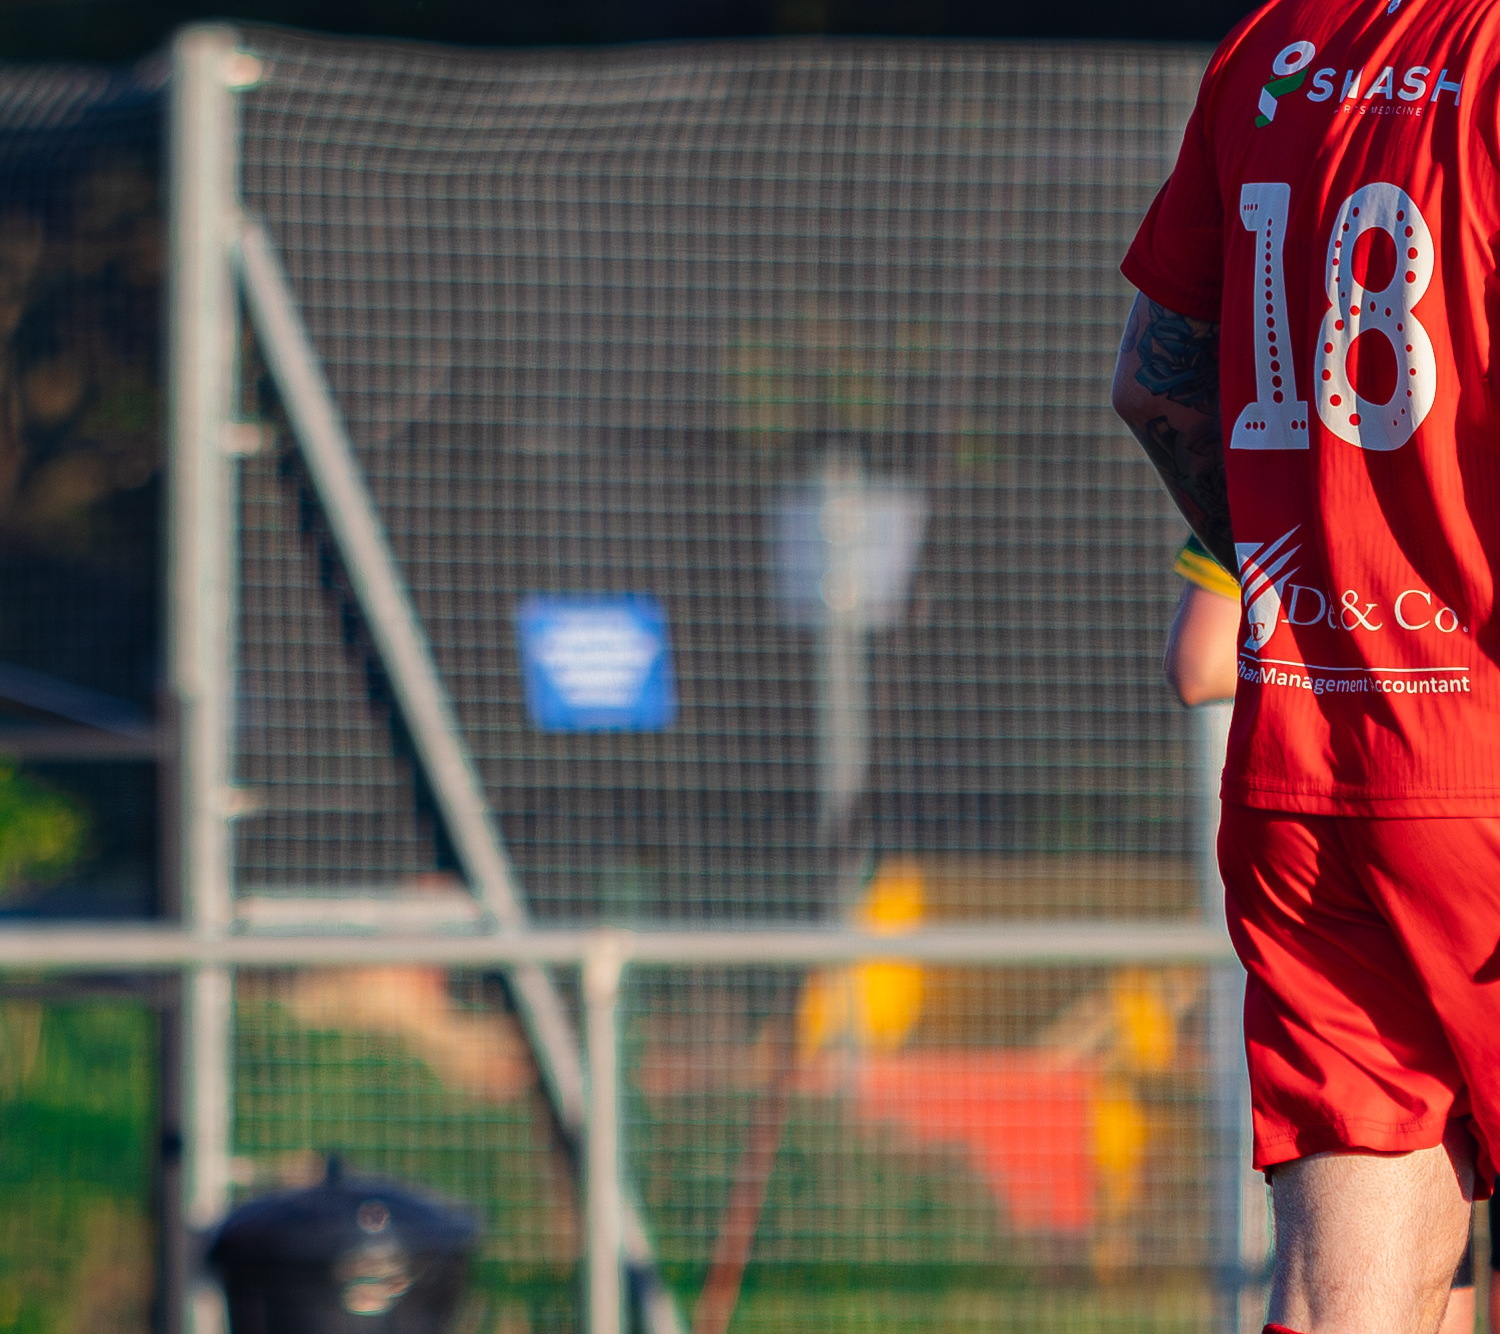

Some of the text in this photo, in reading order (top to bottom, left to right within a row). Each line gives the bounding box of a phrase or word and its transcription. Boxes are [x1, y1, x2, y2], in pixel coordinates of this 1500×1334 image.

[1370, 105, 1423, 117] MEDICINE
[1229, 181, 1437, 452] 18
[1340, 589, 1383, 632] &
[1394, 589, 1469, 633] Co.
[1260, 666, 1369, 696] Management
